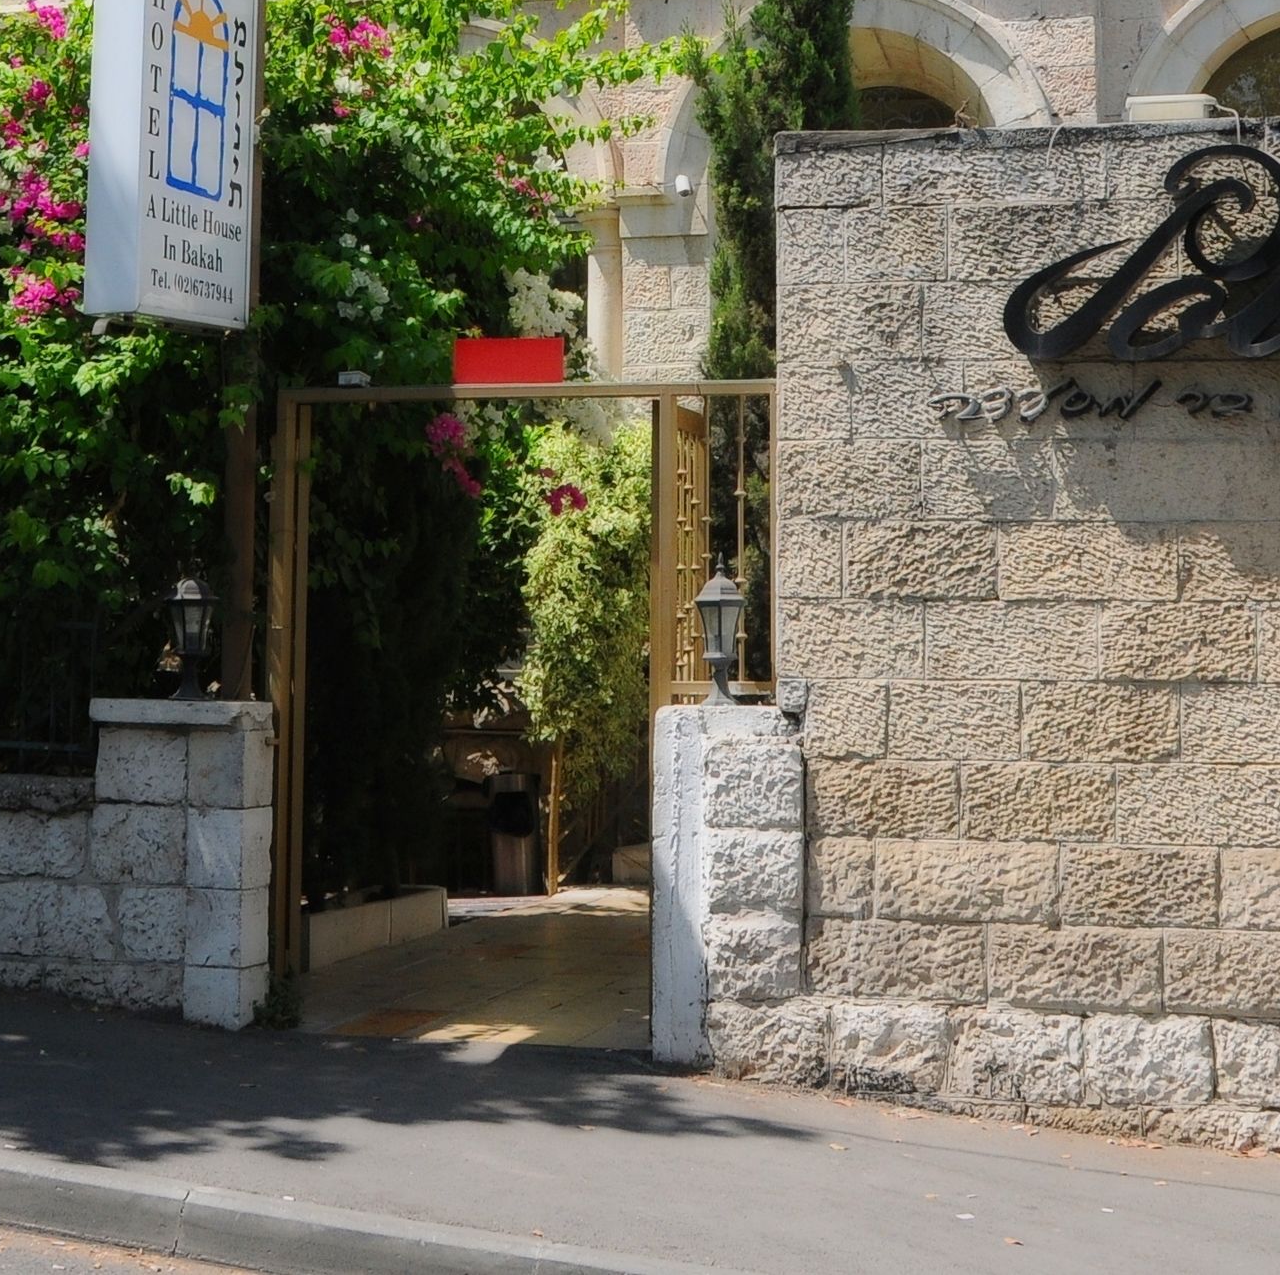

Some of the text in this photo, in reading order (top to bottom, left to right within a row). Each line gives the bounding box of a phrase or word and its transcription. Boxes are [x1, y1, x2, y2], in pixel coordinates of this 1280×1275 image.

[228, 16, 247, 209] מלונית
[146, 193, 242, 243] A Little House
[163, 234, 223, 274] In Bakah
[150, 268, 234, 305] Tel. (02)6737944
